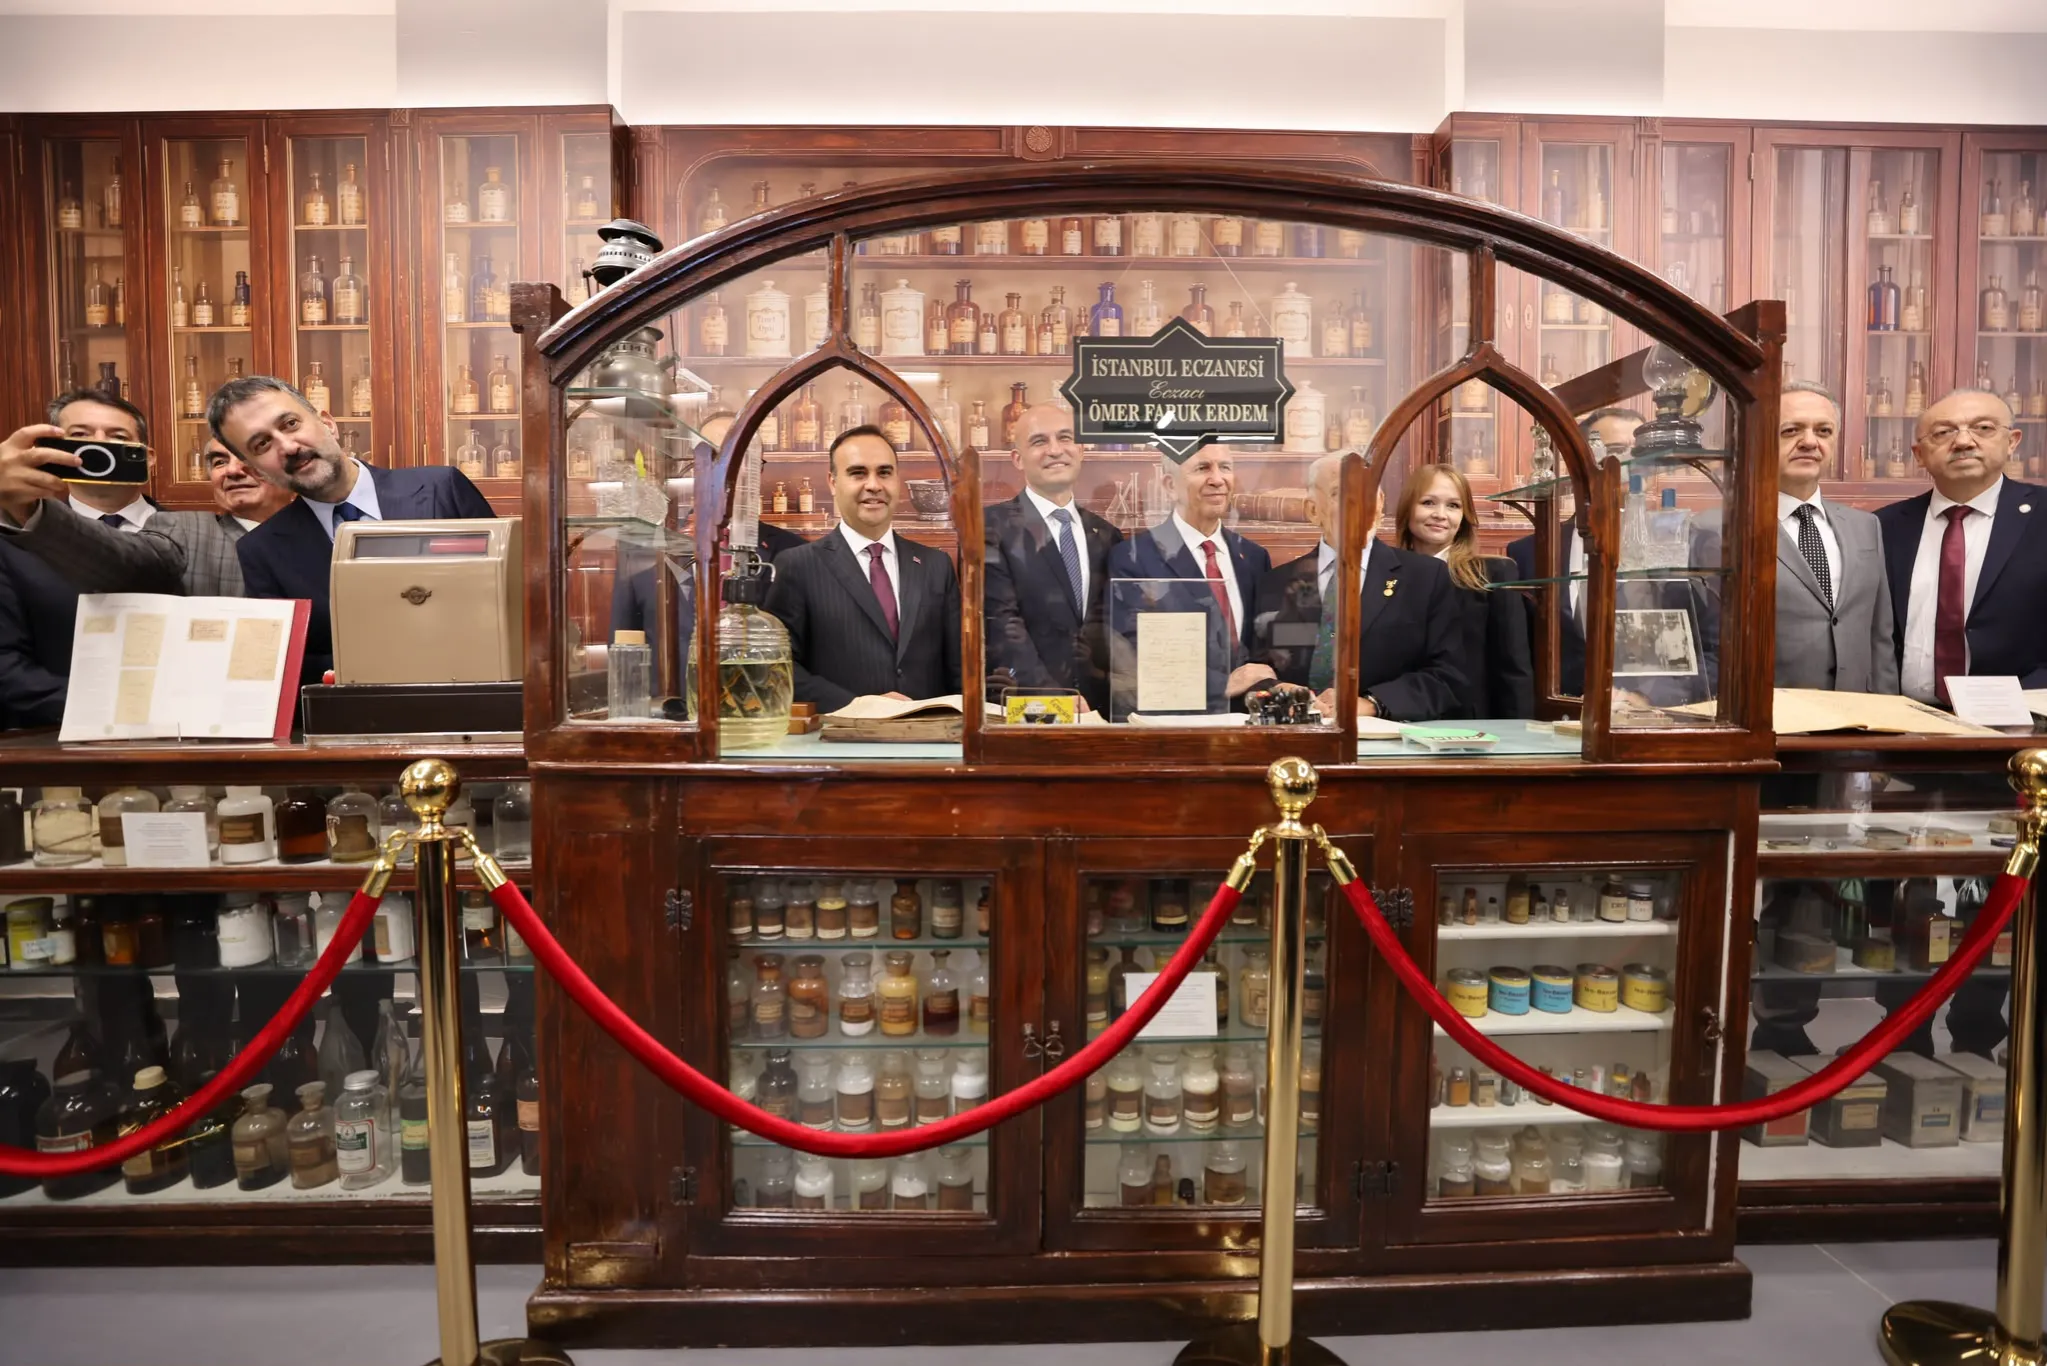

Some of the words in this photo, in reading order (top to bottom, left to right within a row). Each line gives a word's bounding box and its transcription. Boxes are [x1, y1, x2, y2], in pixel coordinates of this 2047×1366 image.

[1092, 354, 1177, 377] İSTANBUL
[1181, 355, 1265, 378] ECZANESİ
[1149, 380, 1205, 399] Eczacı
[1089, 399, 1139, 422] ÖMER
[1205, 404, 1268, 422] ERDEM
